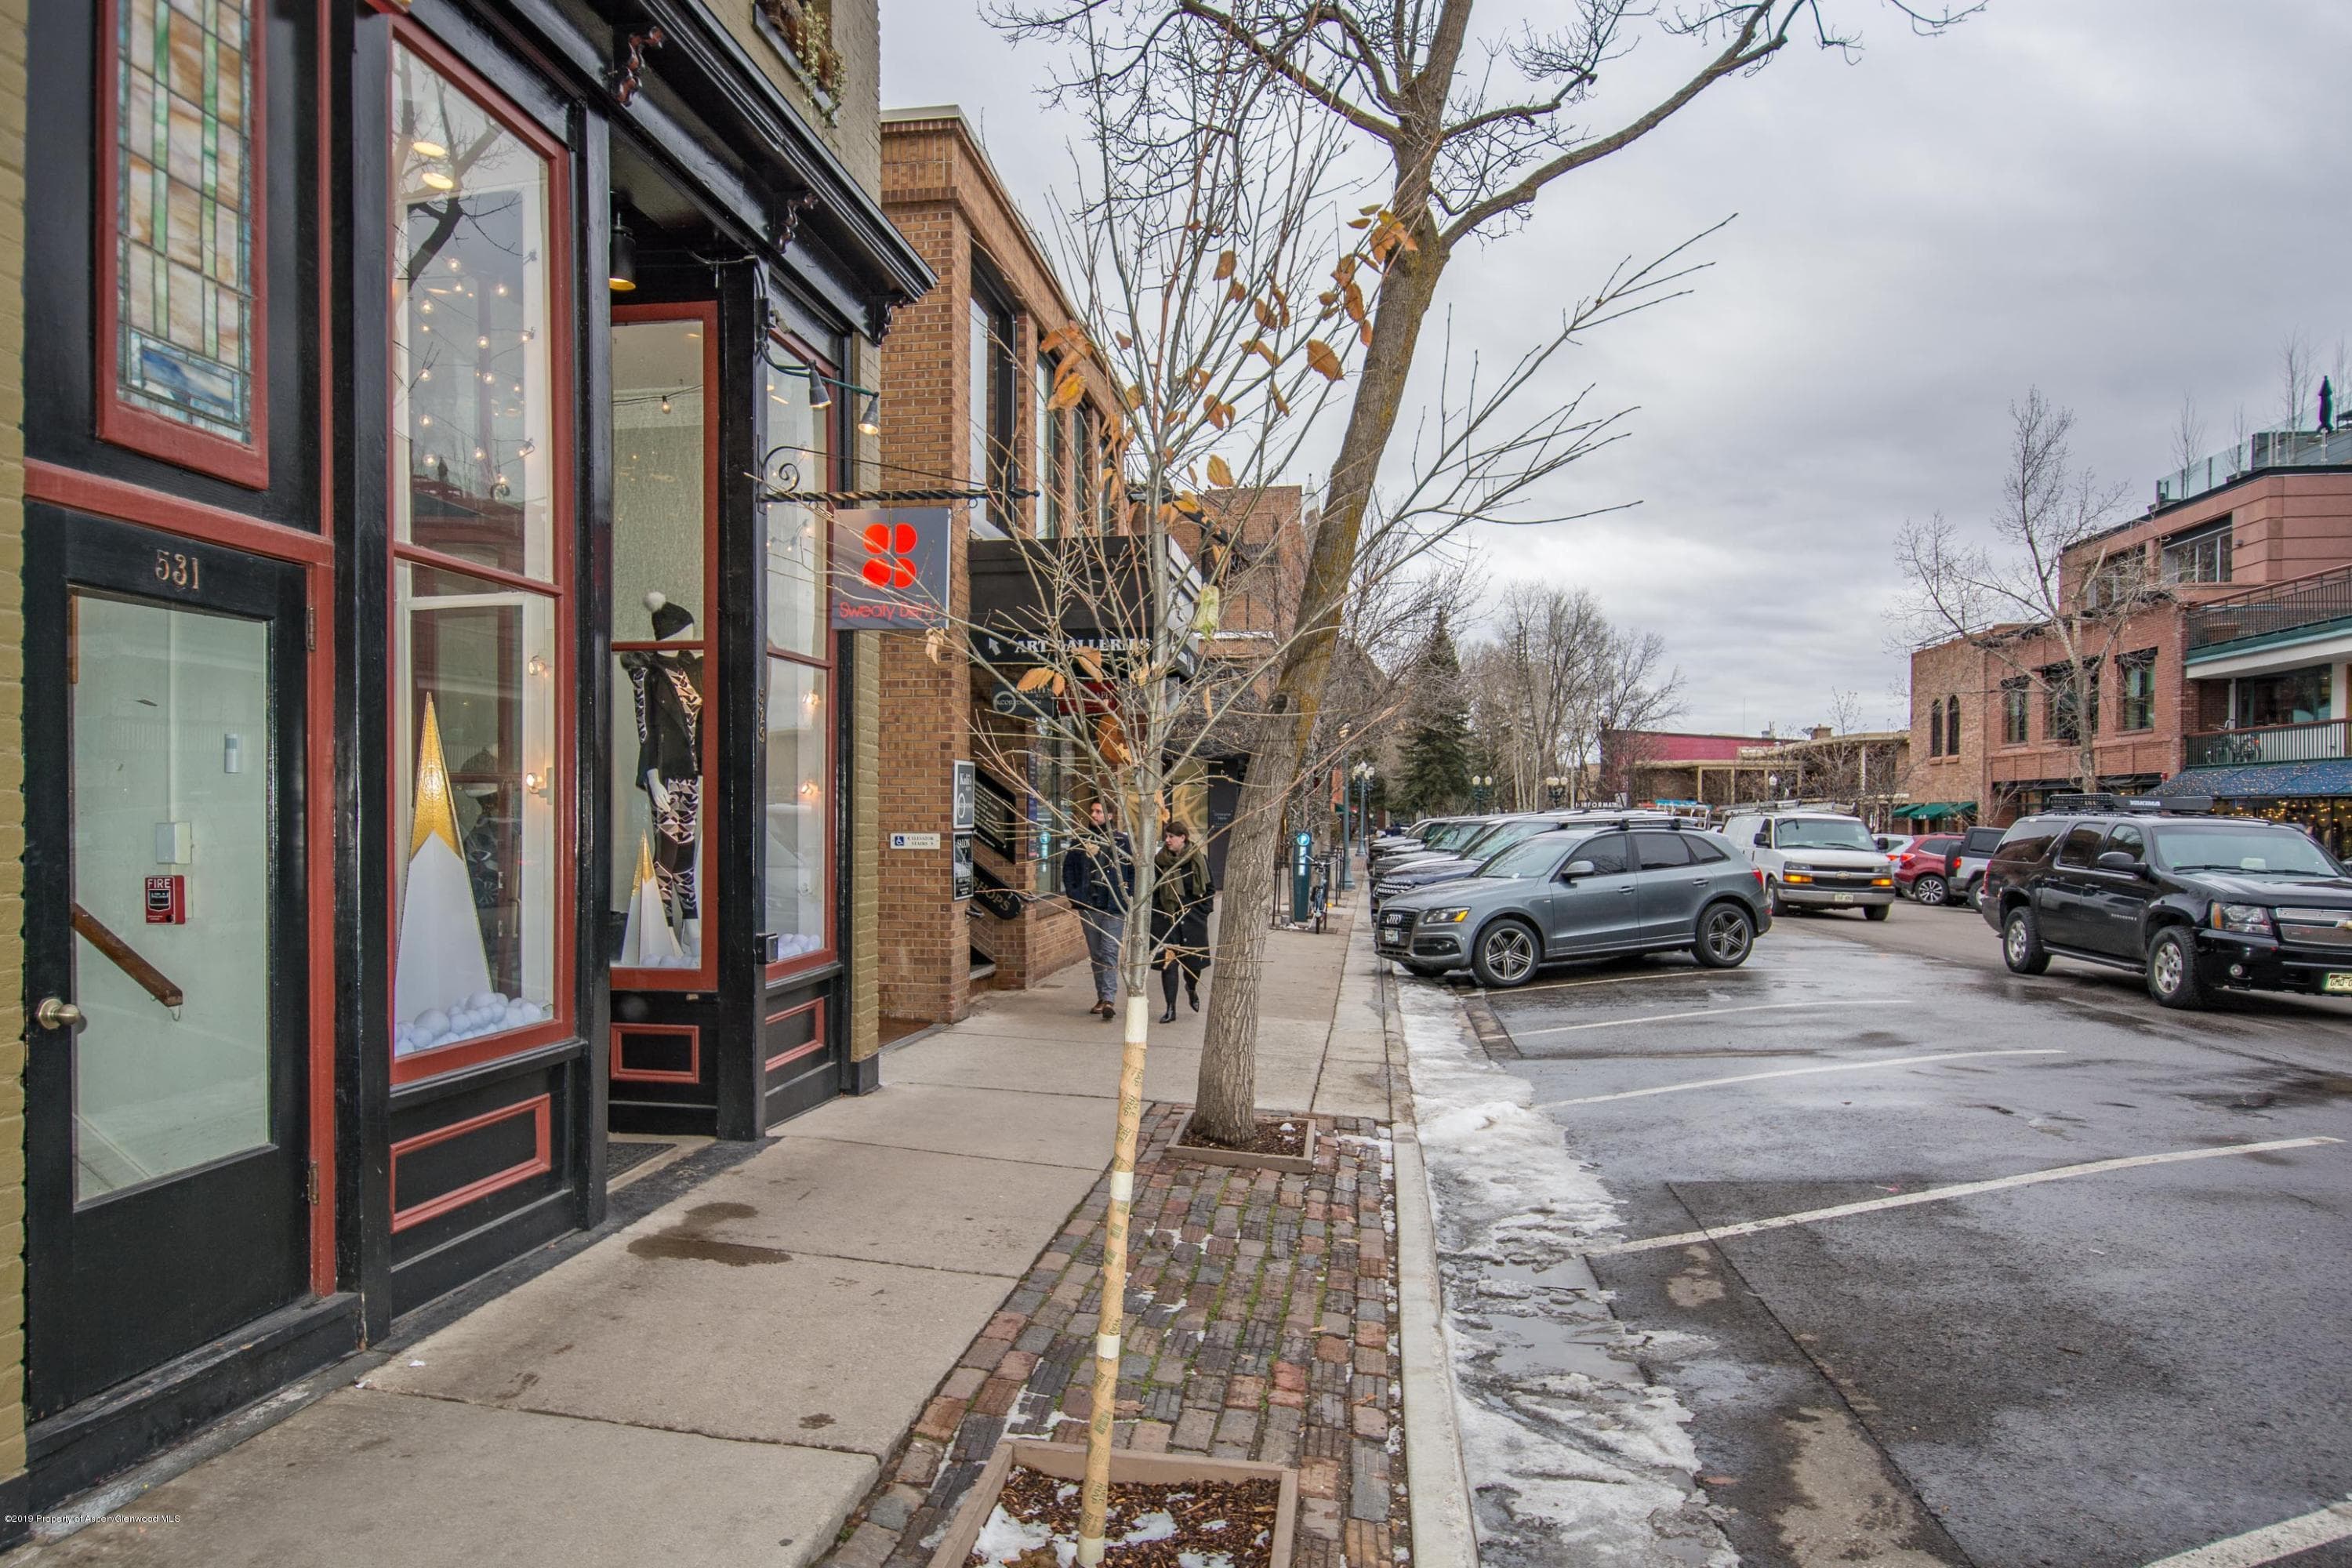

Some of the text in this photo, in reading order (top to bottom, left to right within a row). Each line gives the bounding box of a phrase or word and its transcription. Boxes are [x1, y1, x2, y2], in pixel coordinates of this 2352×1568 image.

[155, 549, 199, 590] 531
[839, 601, 895, 621] Sweaty
[1014, 639, 1048, 653] ART
[147, 878, 171, 889] FIRE
[973, 877, 1011, 911] SHOPS
